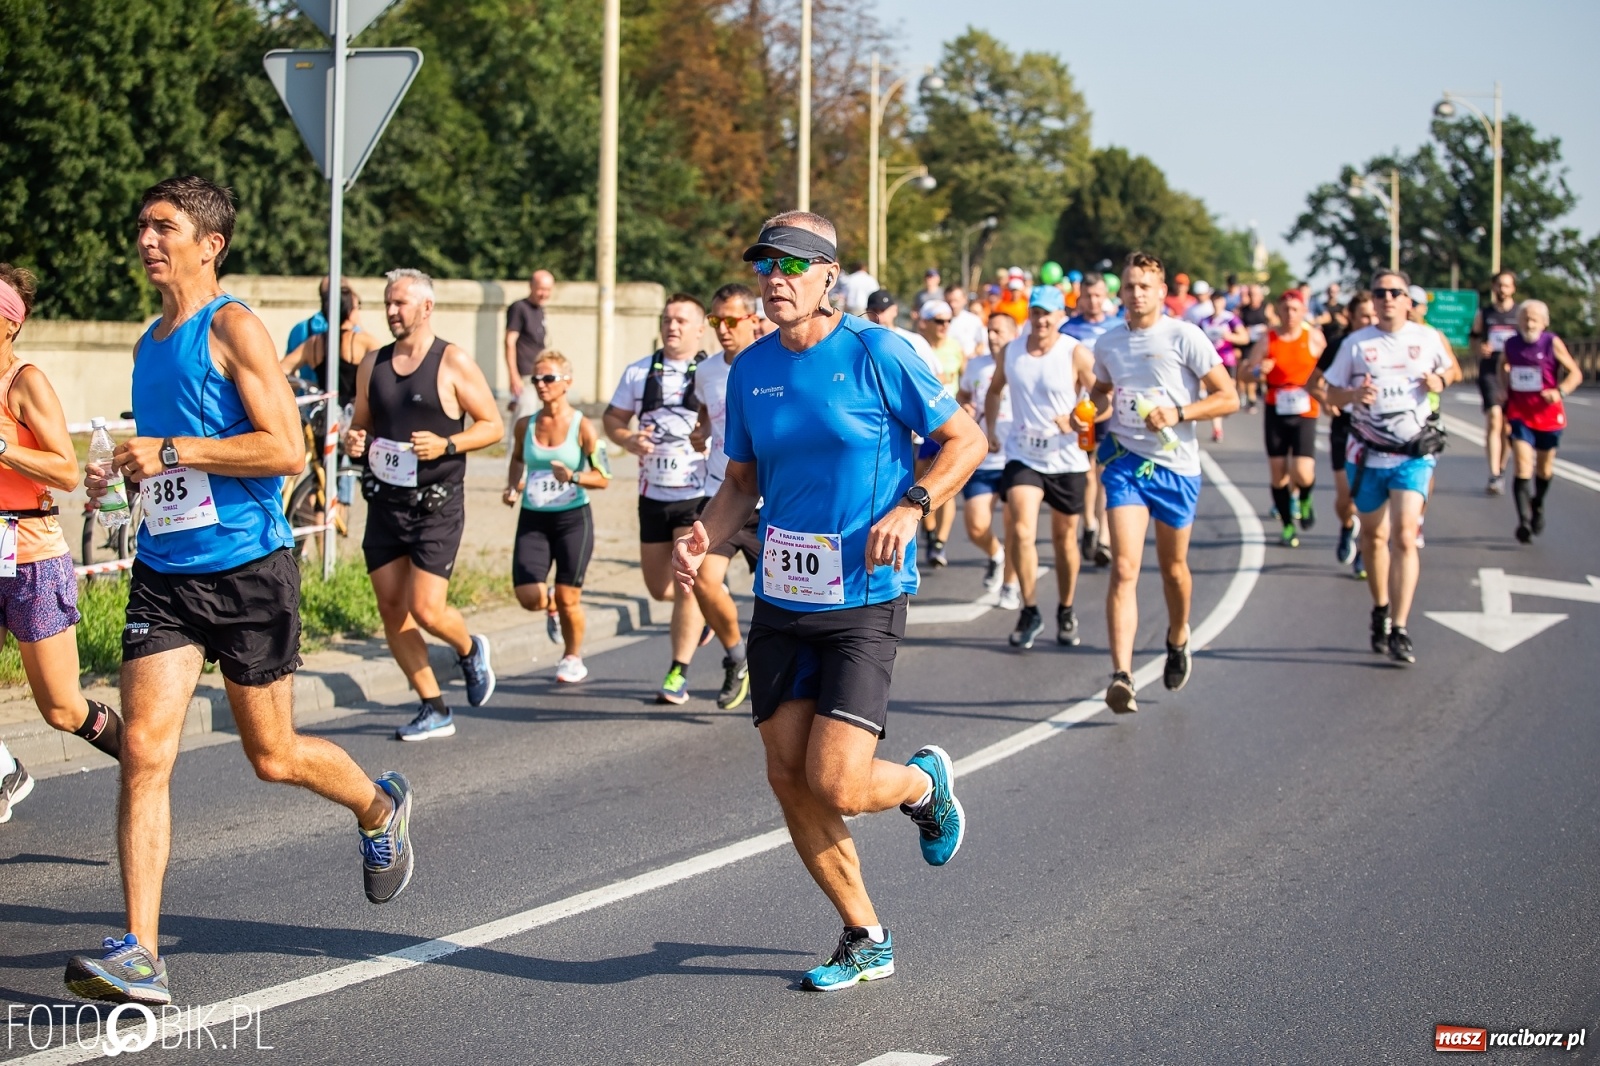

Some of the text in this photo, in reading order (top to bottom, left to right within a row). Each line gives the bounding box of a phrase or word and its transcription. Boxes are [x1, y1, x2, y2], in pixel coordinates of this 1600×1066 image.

[385, 452, 399, 467] 98
[656, 457, 677, 469] 116
[153, 476, 188, 505] 385
[781, 549, 819, 575] 310
